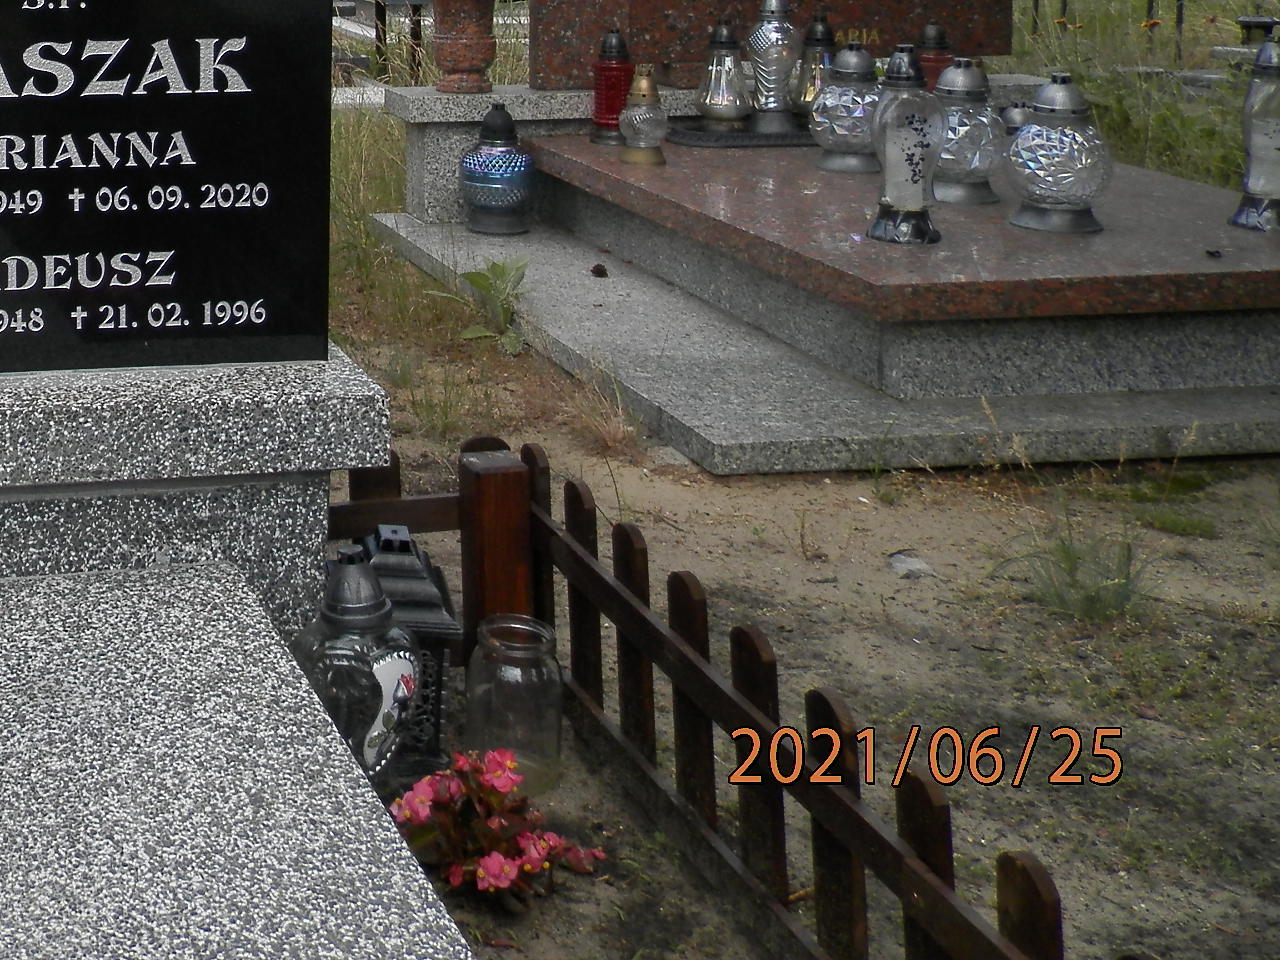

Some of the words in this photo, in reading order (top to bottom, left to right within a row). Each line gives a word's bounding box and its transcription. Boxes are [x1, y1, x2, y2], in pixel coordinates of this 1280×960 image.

[833, 28, 881, 46] ARIA
[95, 185, 138, 212] 06.
[147, 185, 190, 211] 09.
[200, 182, 269, 209] 2020
[98, 303, 138, 329] 21.
[147, 302, 190, 328] 02.
[202, 298, 266, 326] 1996
